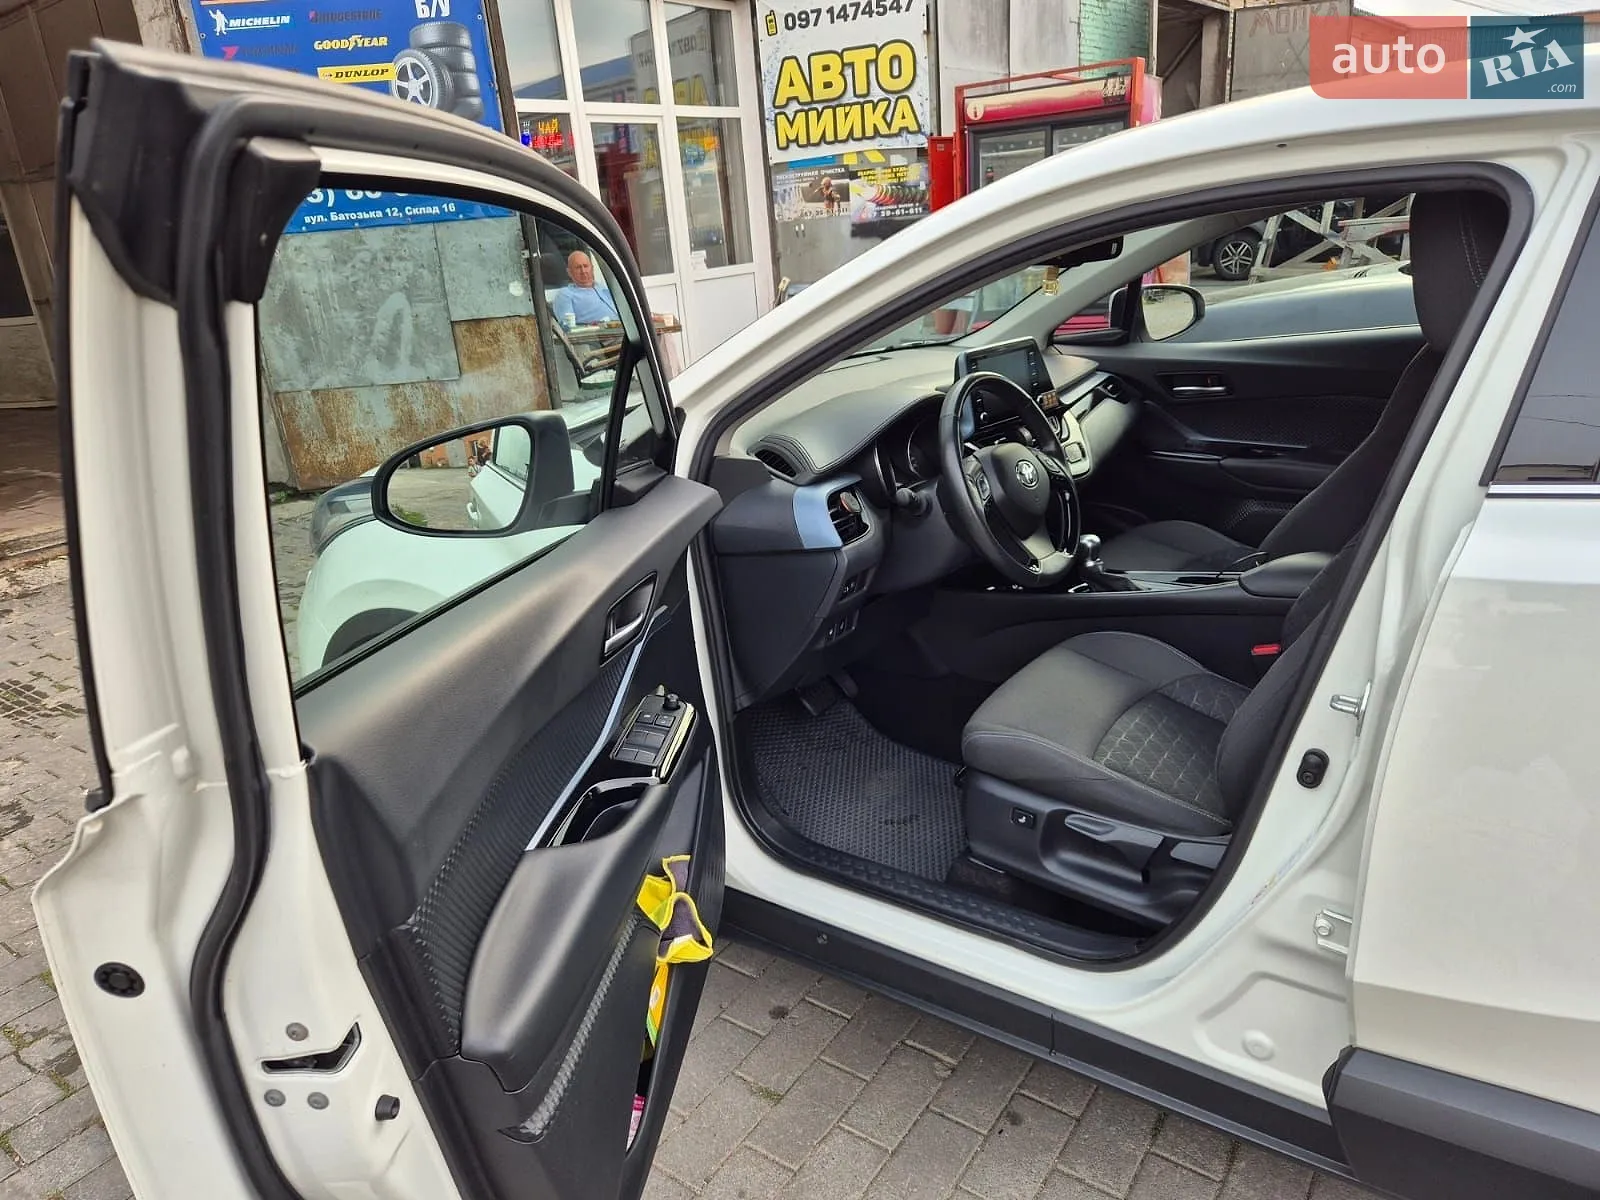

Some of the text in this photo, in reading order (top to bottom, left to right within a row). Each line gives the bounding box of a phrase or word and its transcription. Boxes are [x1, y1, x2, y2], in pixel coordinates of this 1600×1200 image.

[229, 15, 291, 28] MICHELIN
[783, 9, 822, 31] 097
[314, 34, 388, 51] GOODYEAR
[335, 68, 389, 79] DUNLOP
[773, 39, 916, 108] АВТО
[775, 95, 921, 149] МИЙКА
[304, 214, 328, 225] вул.
[385, 207, 402, 218] 12,
[405, 205, 441, 216] Склад
